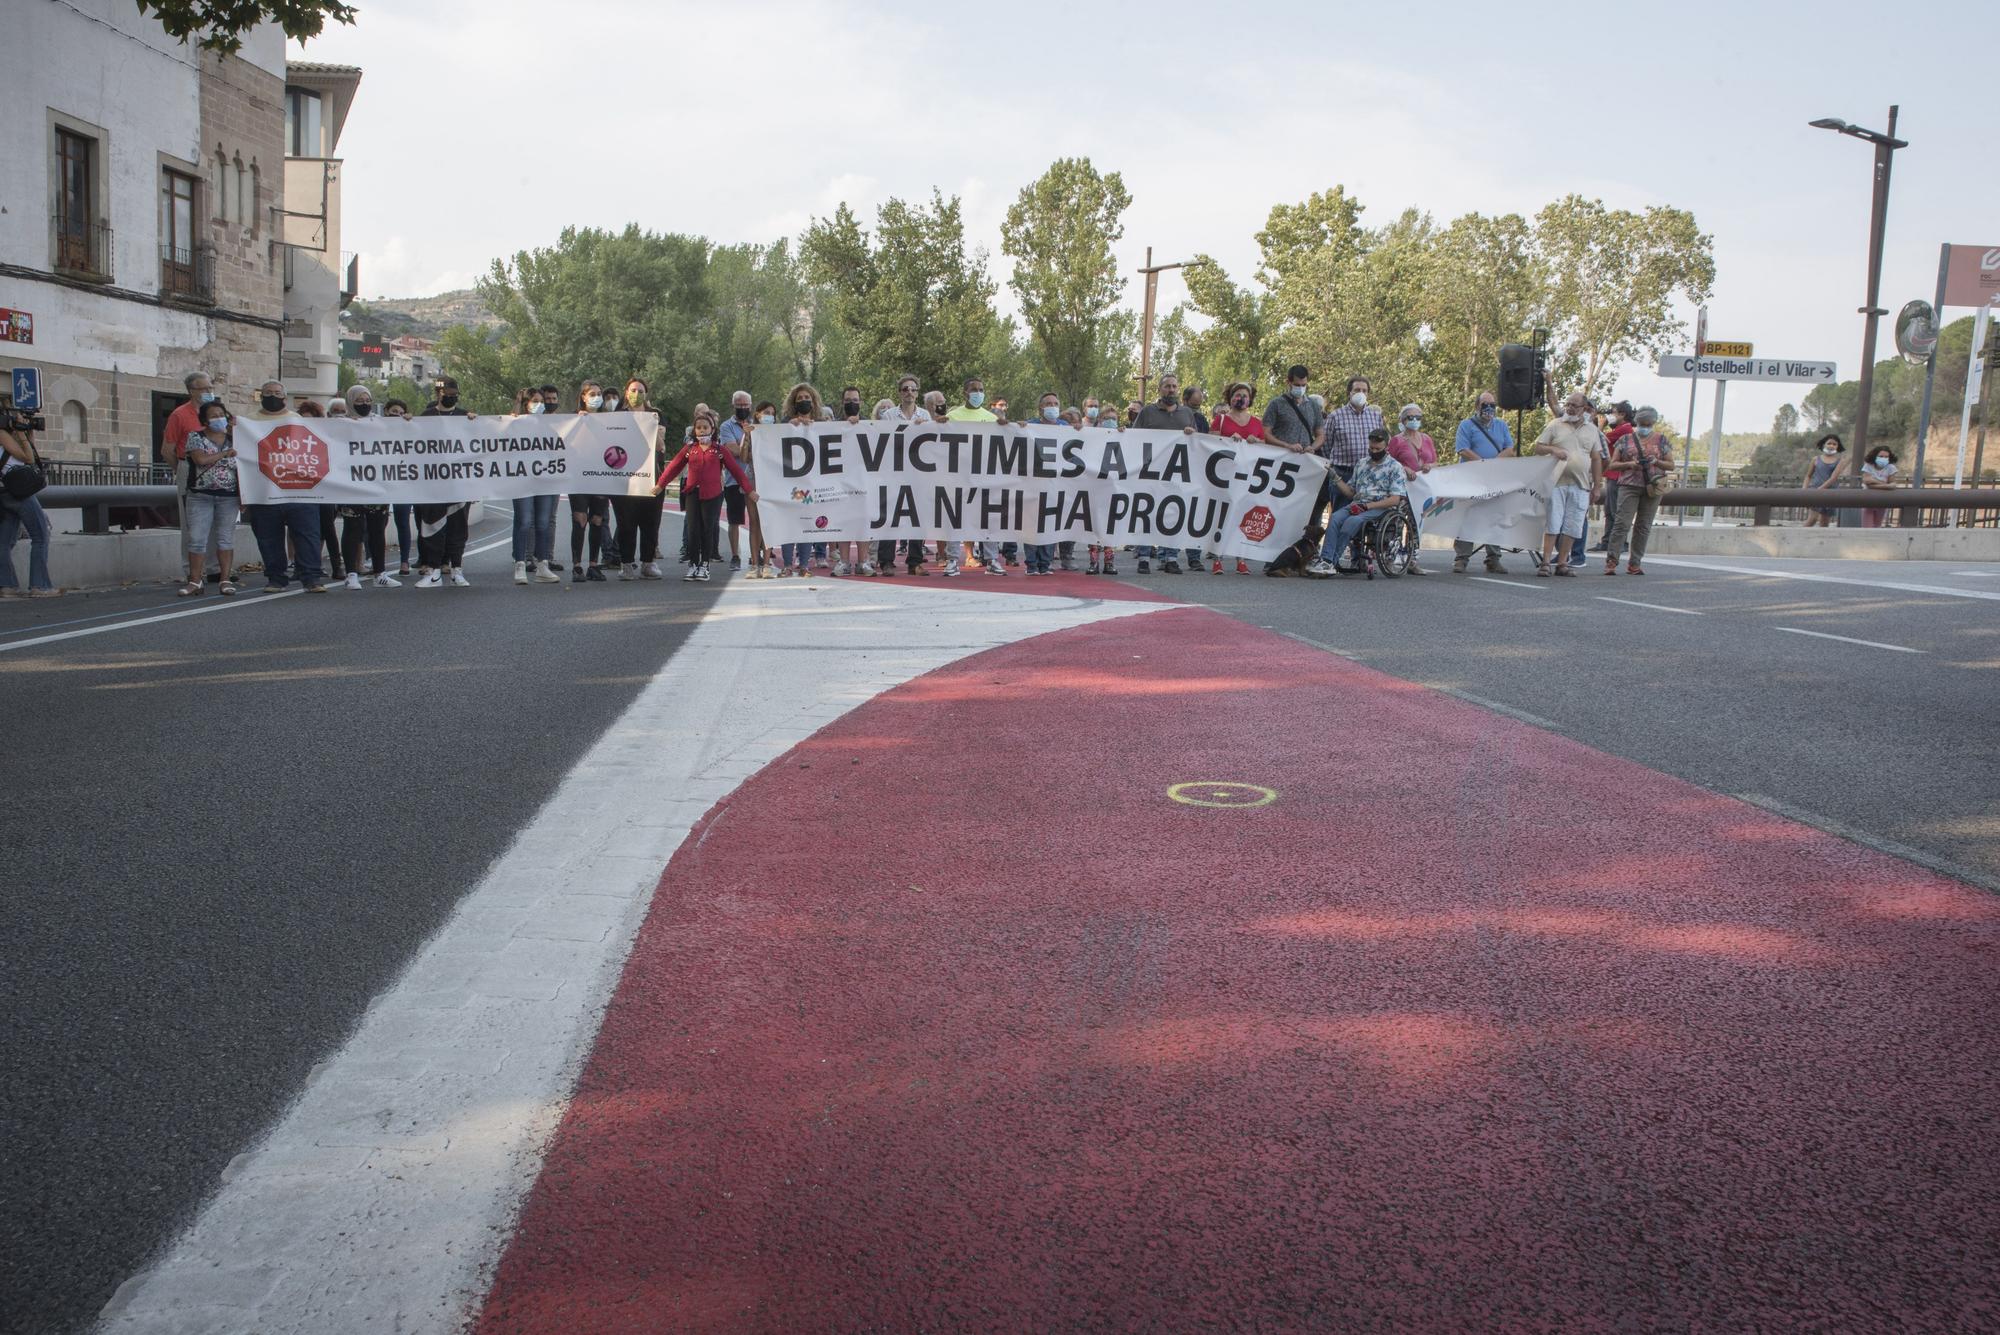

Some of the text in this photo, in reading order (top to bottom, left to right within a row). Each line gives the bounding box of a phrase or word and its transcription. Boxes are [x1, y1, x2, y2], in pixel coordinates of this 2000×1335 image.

[0, 320, 9, 335] T
[1706, 343, 1750, 355] BP-1121
[1758, 361, 1763, 375] i
[1767, 362, 1780, 376] el
[1785, 363, 1816, 377] Vilar
[277, 435, 300, 450] No
[349, 437, 566, 456] PLATAFORMA CIUTADANA
[268, 452, 320, 465] morts
[781, 424, 1301, 498] DE VÍCTIMES A LA C-55
[272, 464, 319, 478] C-55
[350, 458, 566, 481] NO MÉS MORTS A LA C-55
[870, 485, 1229, 543] JA N'HI HA PROU!
[1252, 511, 1263, 520] No
[1245, 520, 1269, 530] morts
